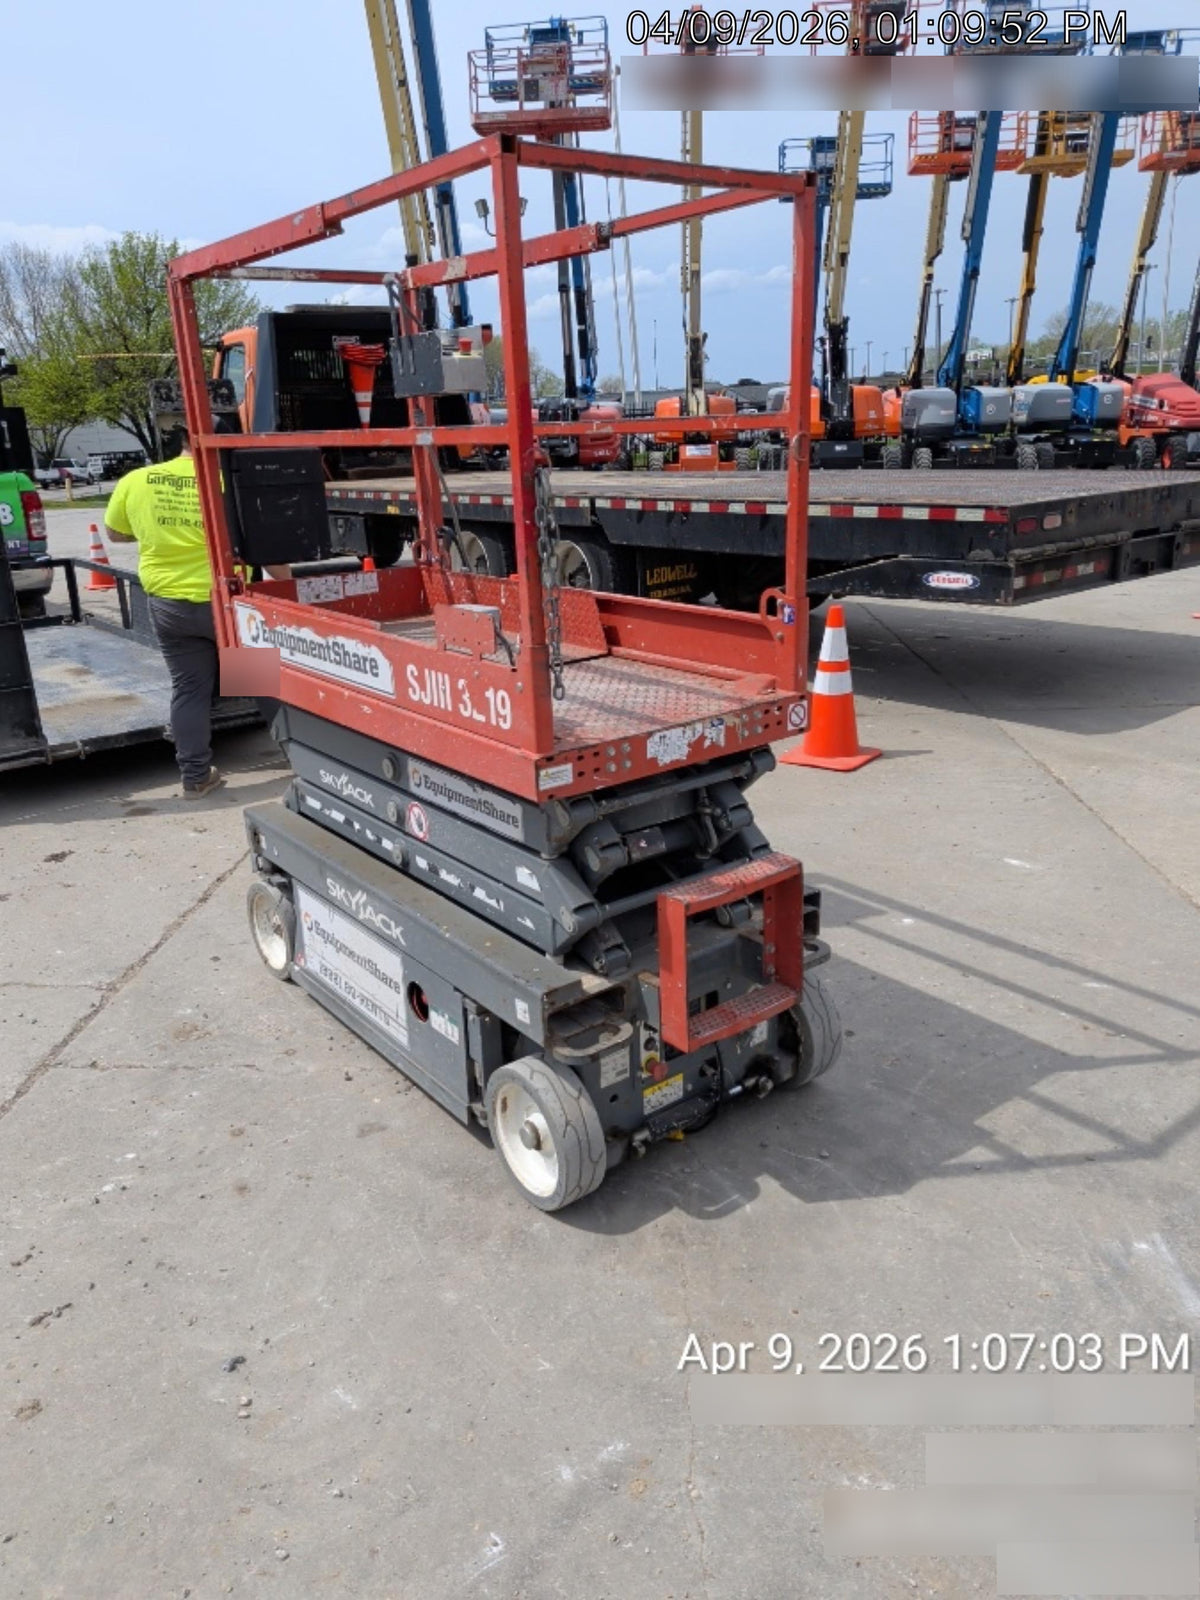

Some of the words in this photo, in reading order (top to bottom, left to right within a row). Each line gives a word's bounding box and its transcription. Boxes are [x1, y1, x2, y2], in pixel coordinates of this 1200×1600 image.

[260, 621, 379, 678] EquipmentShare
[423, 775, 519, 829] EquipmentShare
[326, 878, 406, 946] SKYJACK
[314, 920, 401, 995] EquipmentShare
